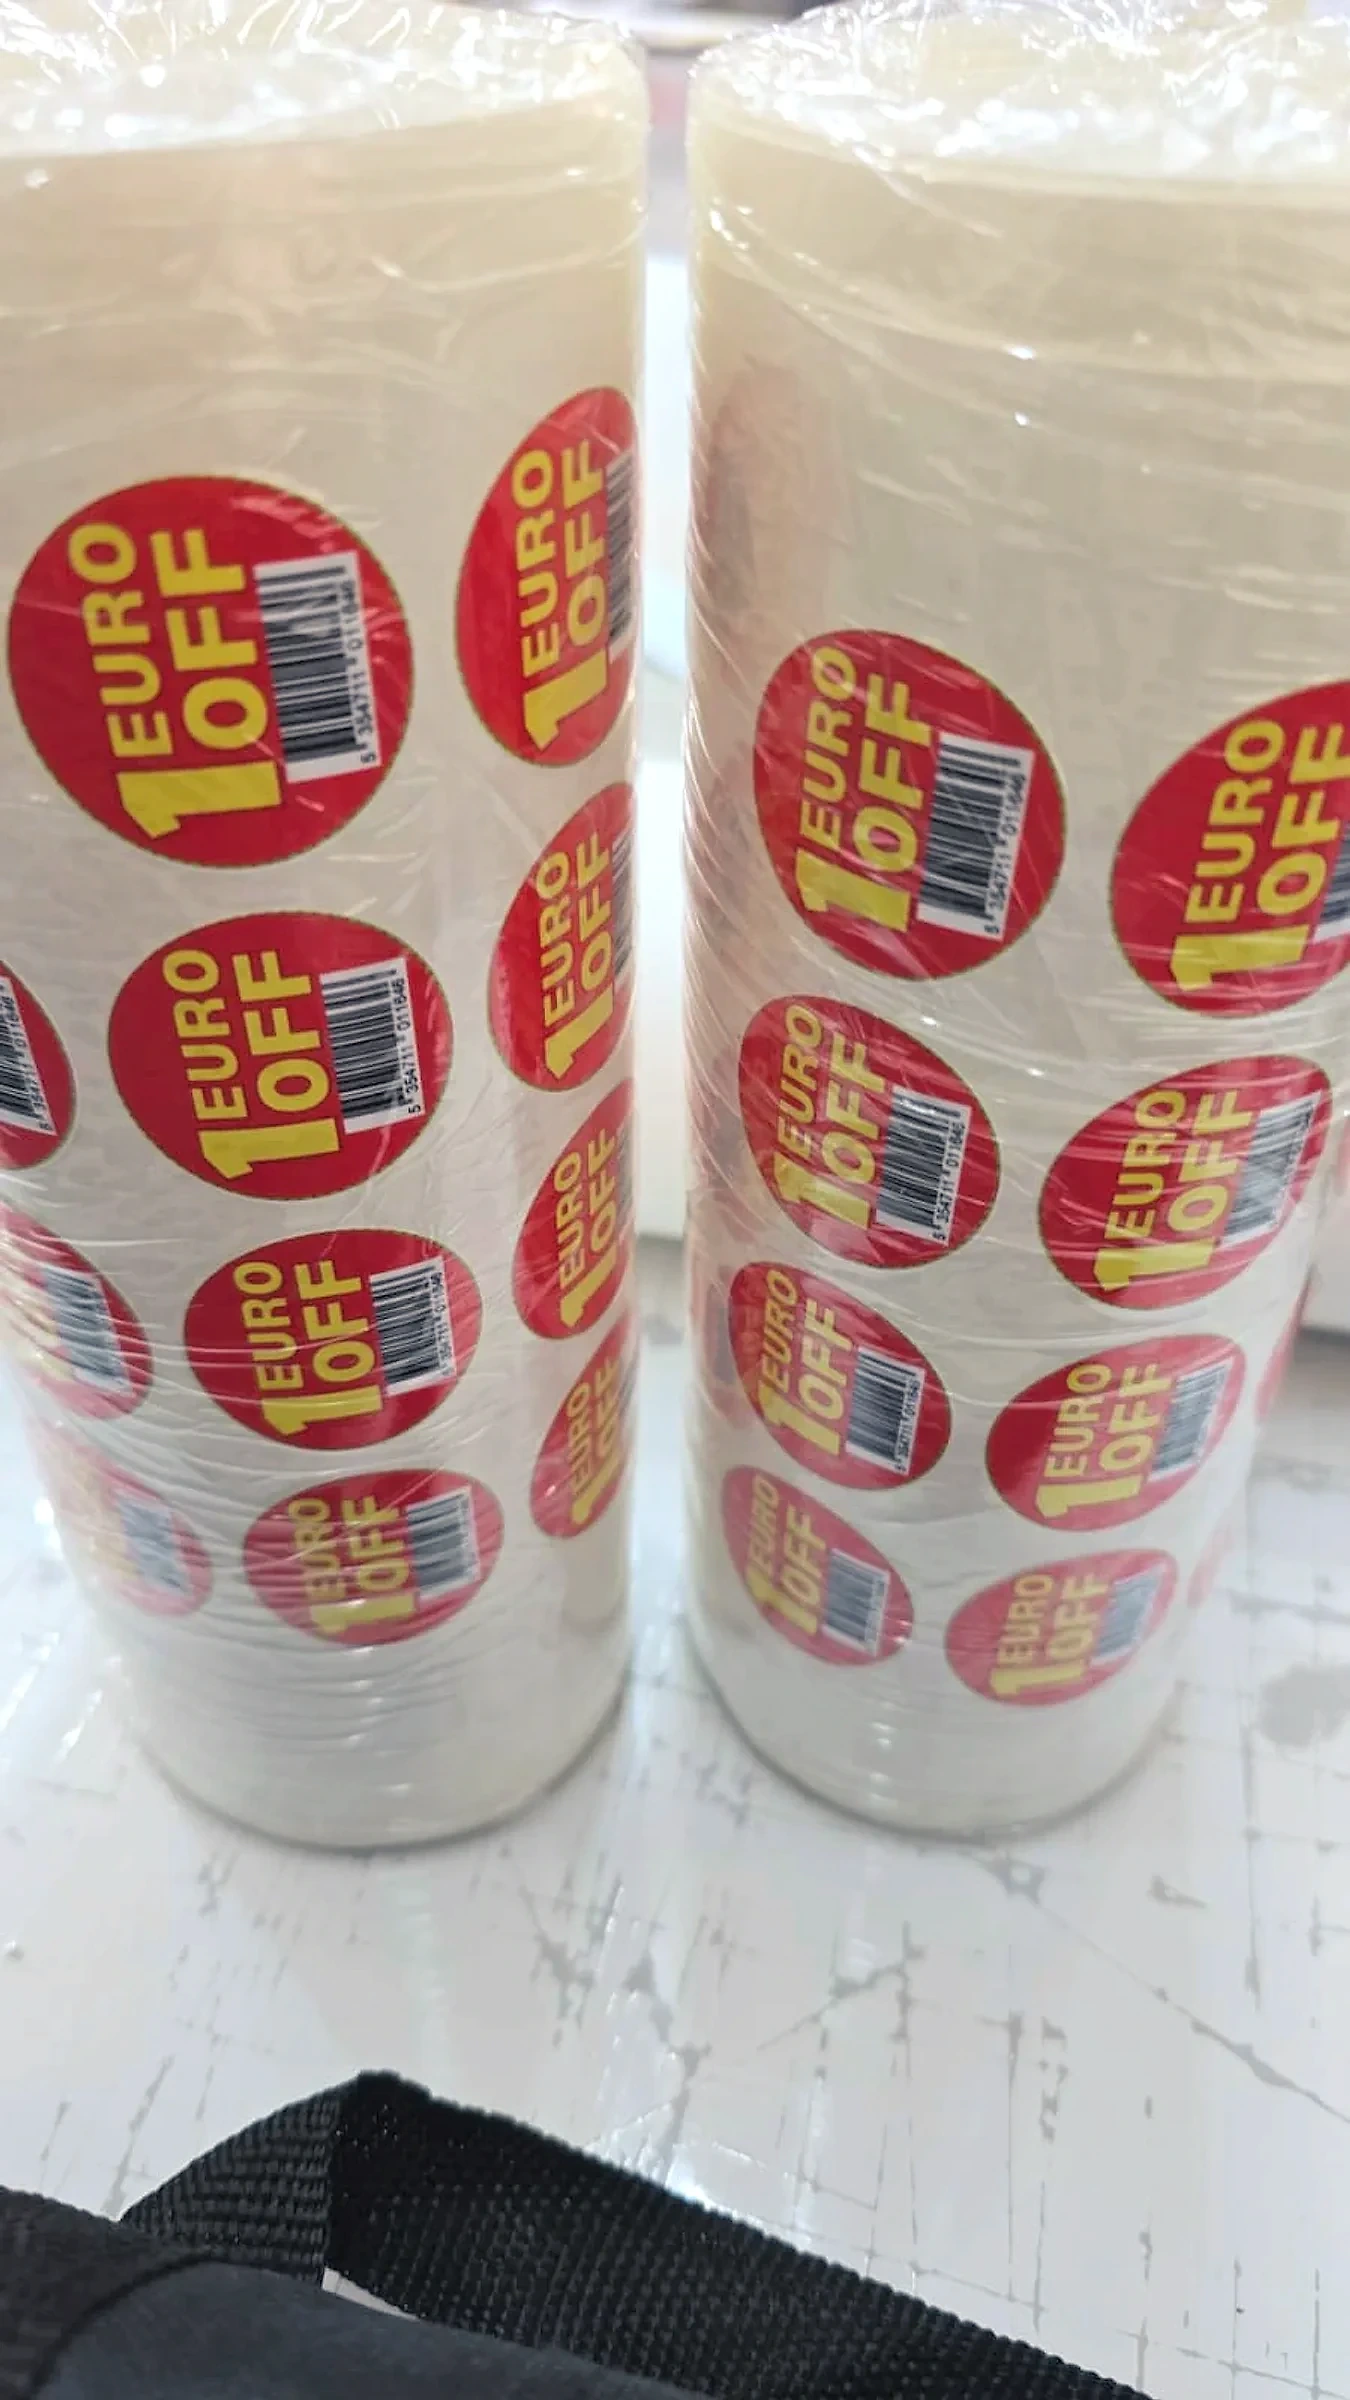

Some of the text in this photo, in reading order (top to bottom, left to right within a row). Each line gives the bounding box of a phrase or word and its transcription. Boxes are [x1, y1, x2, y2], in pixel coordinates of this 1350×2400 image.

[511, 448, 608, 752] 1 EURO
[561, 439, 606, 646] OFF
[68, 522, 282, 839] 1 EURO
[150, 529, 269, 750] OFF
[796, 646, 911, 933] 1 EURO
[853, 672, 932, 872] OFF
[576, 832, 612, 992] OFF
[1170, 720, 1309, 992] 1 EURO
[233, 950, 330, 1112] OFF
[390, 977, 411, 1031] 011646
[536, 852, 614, 1080] 1 EURO
[162, 949, 340, 1179] 1 EURO
[399, 1044, 419, 1094] 354711
[774, 1004, 871, 1230] 1 EURO
[821, 1032, 885, 1184] OFF
[554, 1151, 617, 1328] 1 EURO
[587, 1128, 617, 1252] OFF
[1094, 1090, 1217, 1292] 1 EURO
[1167, 1090, 1253, 1232] OFF
[233, 1261, 383, 1436] 1 EURO
[294, 1260, 375, 1382] OFF
[758, 1269, 840, 1456] 1 EURO
[798, 1299, 853, 1420] OFF
[1036, 1363, 1144, 1519] 1 EURO
[1100, 1363, 1172, 1472] OFF
[288, 1498, 416, 1634] 1 EURO
[342, 1496, 410, 1592] OFF
[781, 1503, 826, 1606] OFF
[1048, 1572, 1108, 1659] OFF
[990, 1574, 1085, 1698] 1 EURO
